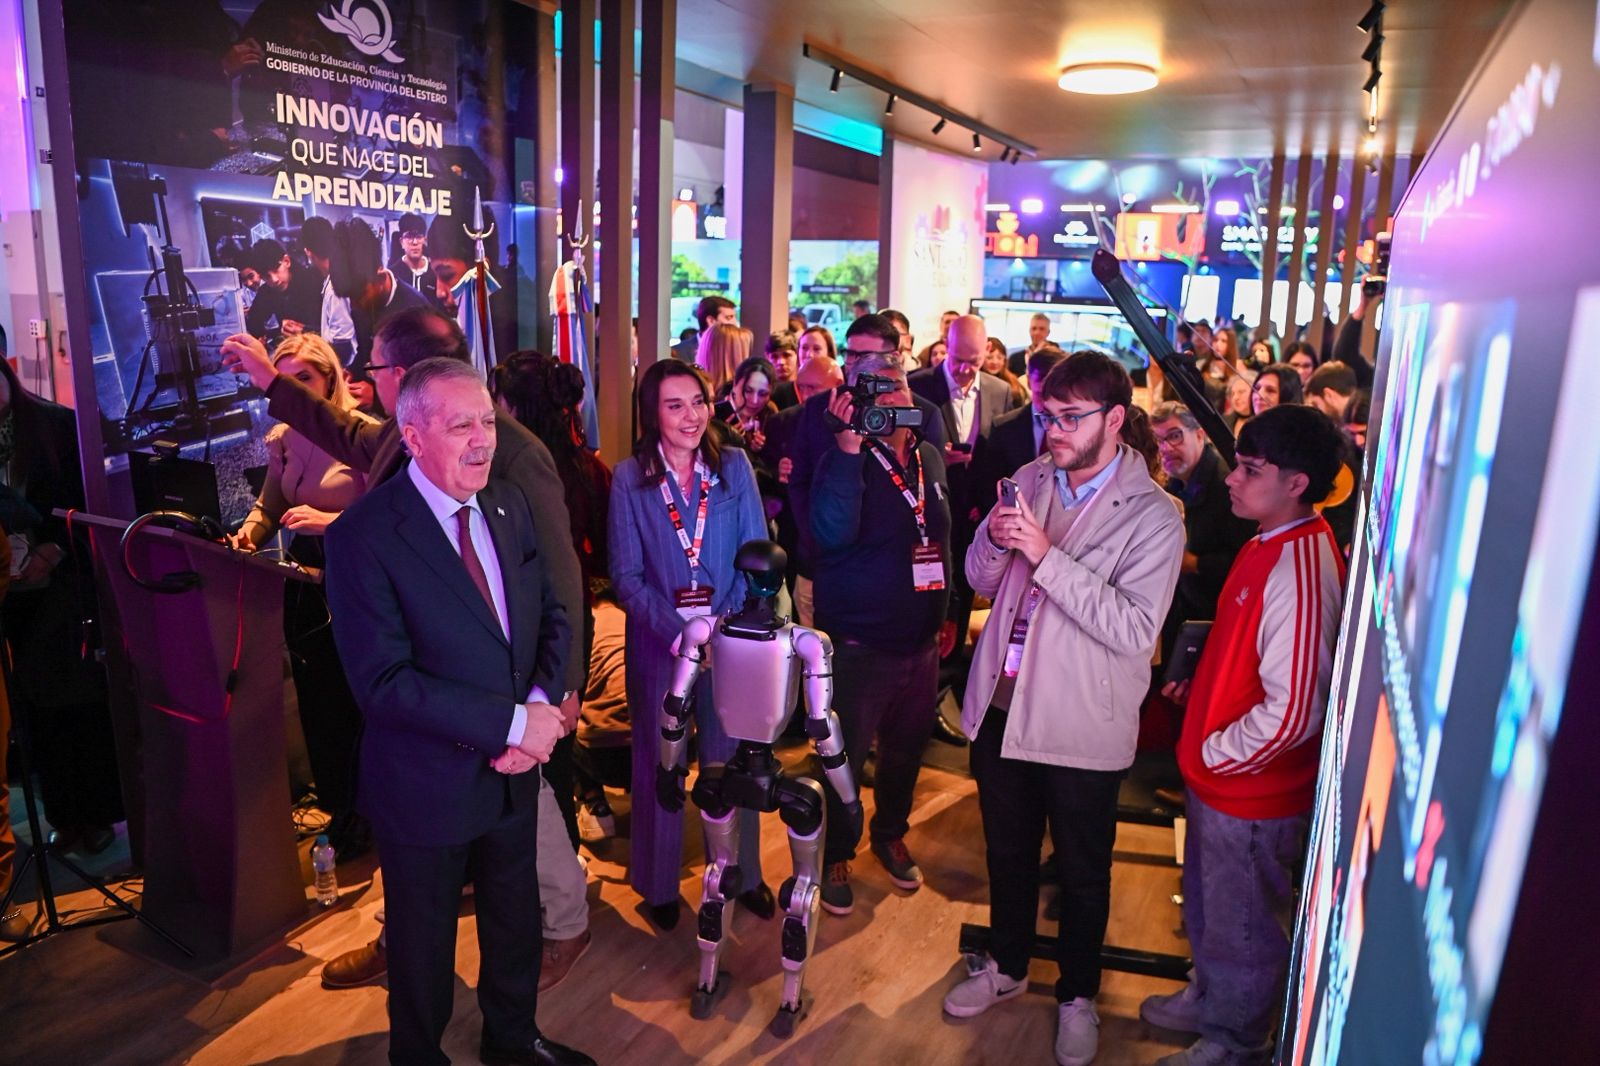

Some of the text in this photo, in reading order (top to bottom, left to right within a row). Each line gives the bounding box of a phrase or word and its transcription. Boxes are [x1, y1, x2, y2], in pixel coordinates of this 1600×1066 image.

[266, 41, 308, 60] Ministerio
[308, 51, 319, 62] de
[369, 65, 399, 80] Ciencia
[400, 74, 407, 83] y
[266, 57, 448, 105] GOBIERNO DE LA PROVINCIA DEL ESTERO
[276, 93, 443, 148] INNOVACIÓN
[291, 138, 434, 178] QUE NACE DEL
[272, 171, 452, 216] APRENDIZAJE
